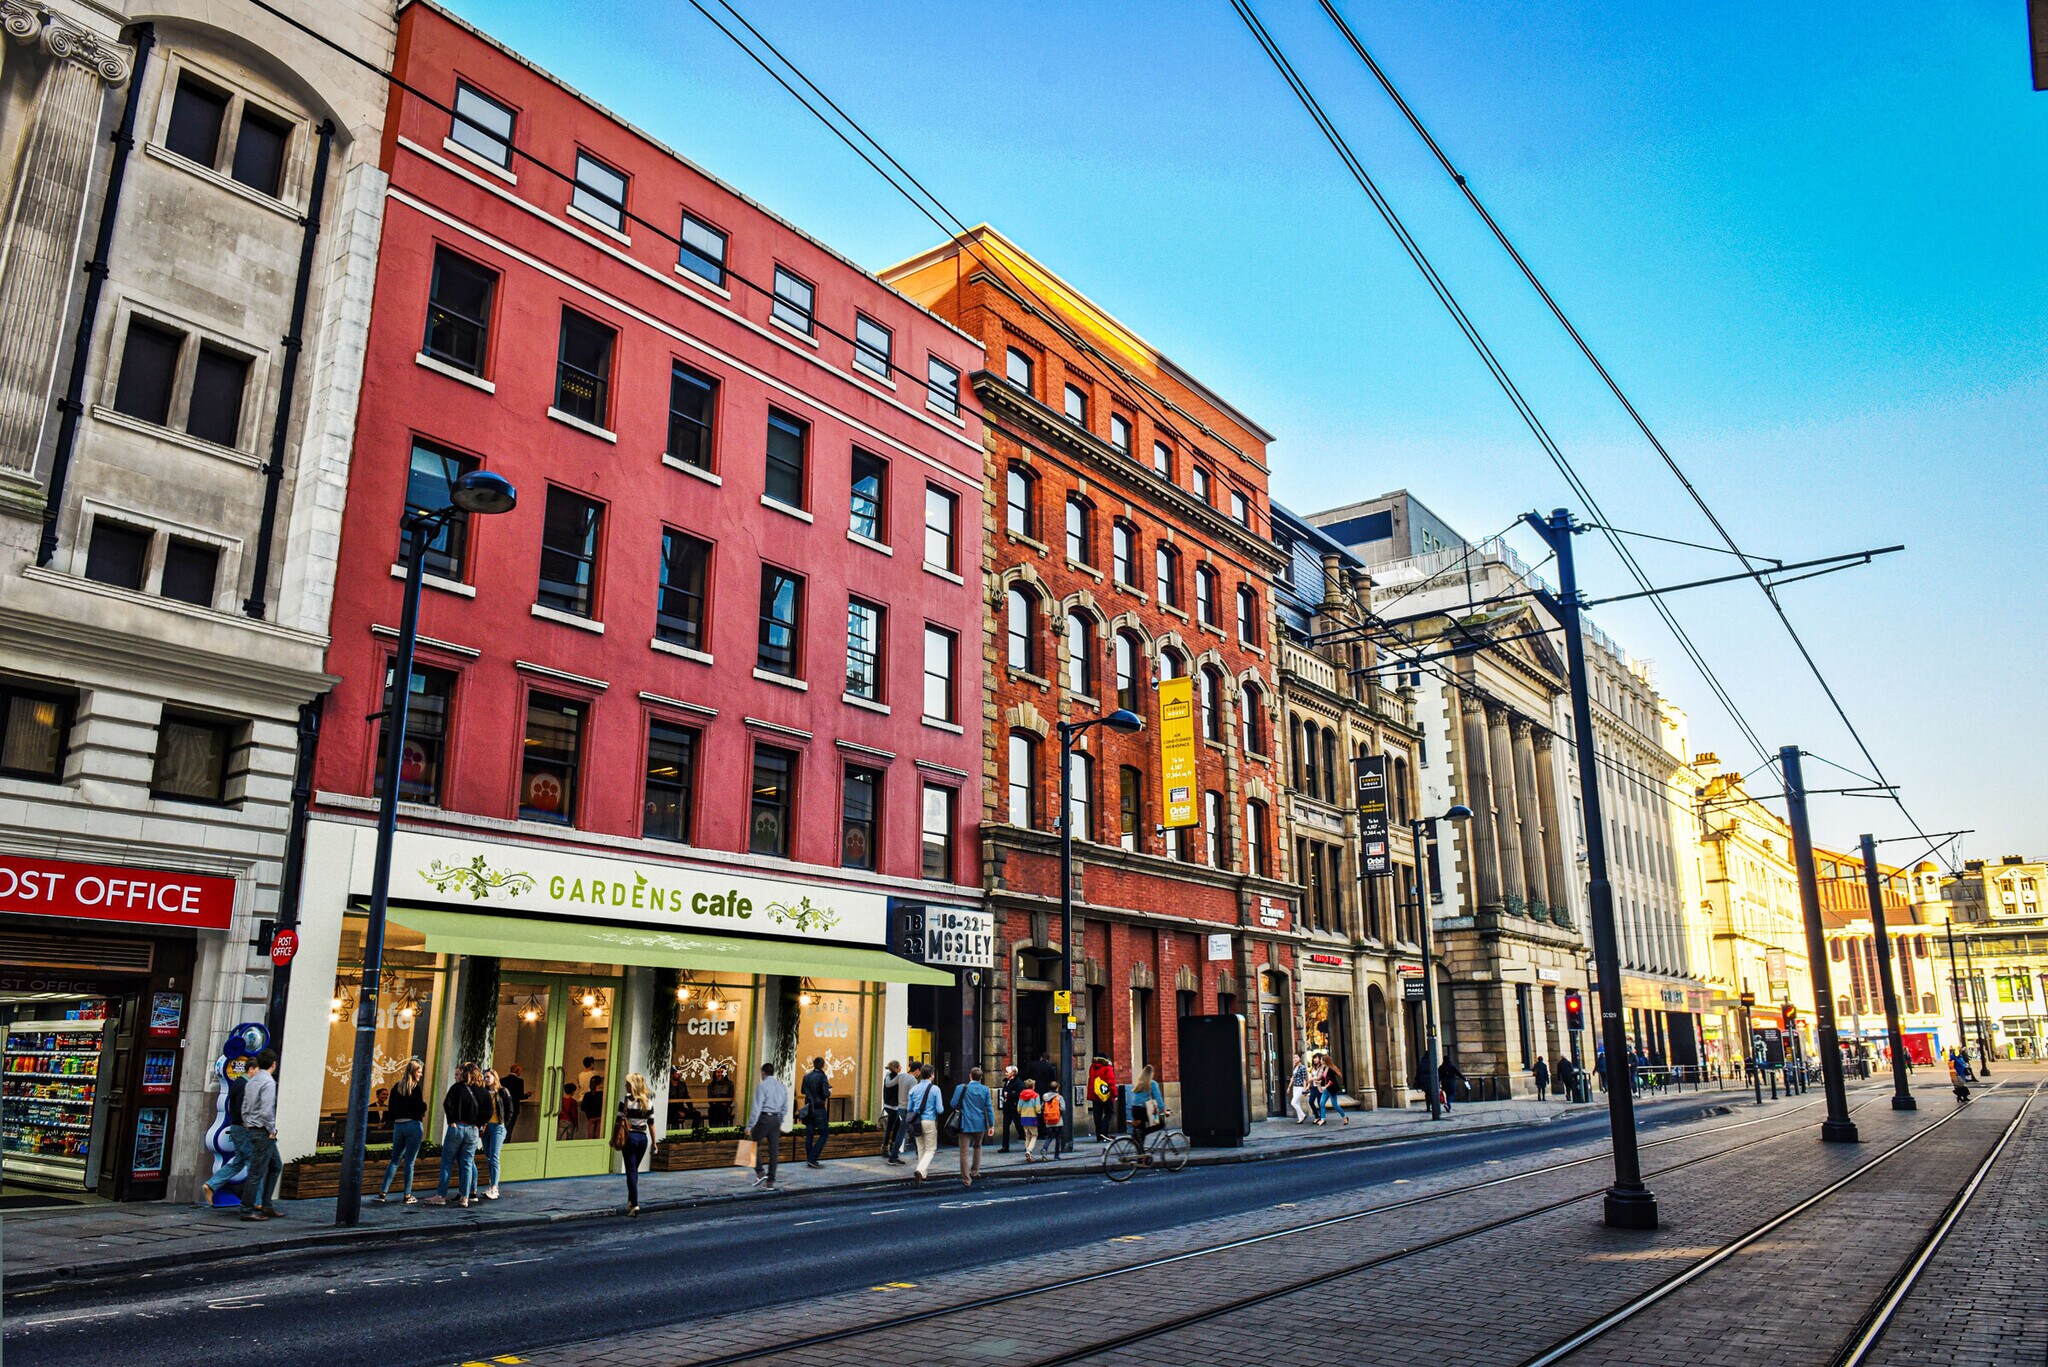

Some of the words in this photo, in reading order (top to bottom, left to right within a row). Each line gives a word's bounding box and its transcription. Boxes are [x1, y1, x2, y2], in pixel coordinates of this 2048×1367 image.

[1170, 805, 1190, 815] Orbit
[1367, 856, 1385, 865] Orbit
[75, 876, 202, 914] OFFICE
[550, 875, 682, 913] GARDENS
[691, 889, 753, 919] cafe
[1260, 896, 1271, 907] THE
[1260, 906, 1285, 919] SLIMMING
[905, 914, 922, 931] 18
[1260, 916, 1279, 927] CLINIC
[278, 936, 292, 946] POST
[903, 938, 924, 955] 22
[928, 930, 991, 960] MOSLEY
[273, 947, 292, 957] OFFICE
[946, 954, 989, 964] STREET
[30, 980, 97, 992] OFFICE
[687, 1013, 729, 1036] cafe
[813, 1016, 849, 1038] cafe
